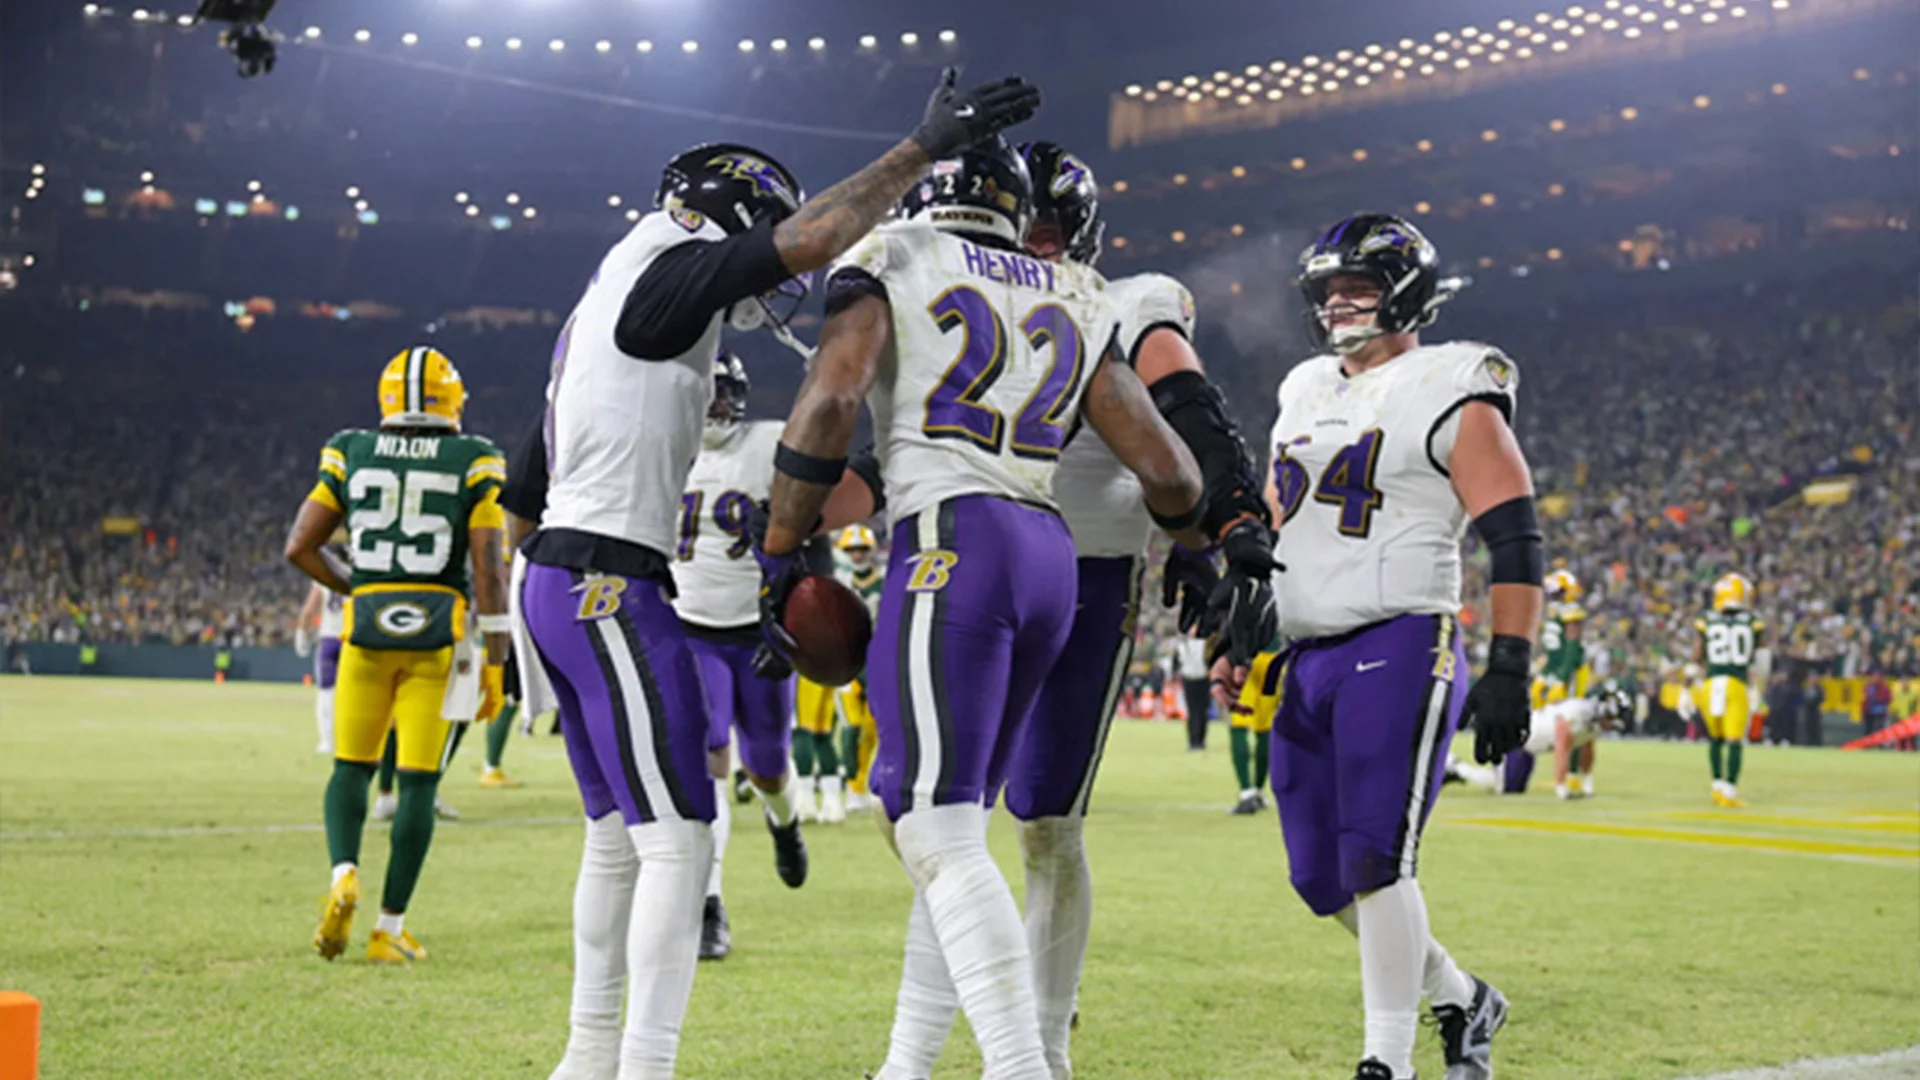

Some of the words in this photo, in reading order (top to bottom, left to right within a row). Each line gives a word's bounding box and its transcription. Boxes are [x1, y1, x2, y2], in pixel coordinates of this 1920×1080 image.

[961, 243, 1056, 291] HENRY
[923, 285, 1085, 461] 22
[374, 435, 440, 459] NIXON
[349, 468, 459, 574] 25
[678, 489, 756, 561] 19
[1707, 624, 1753, 665] 20
